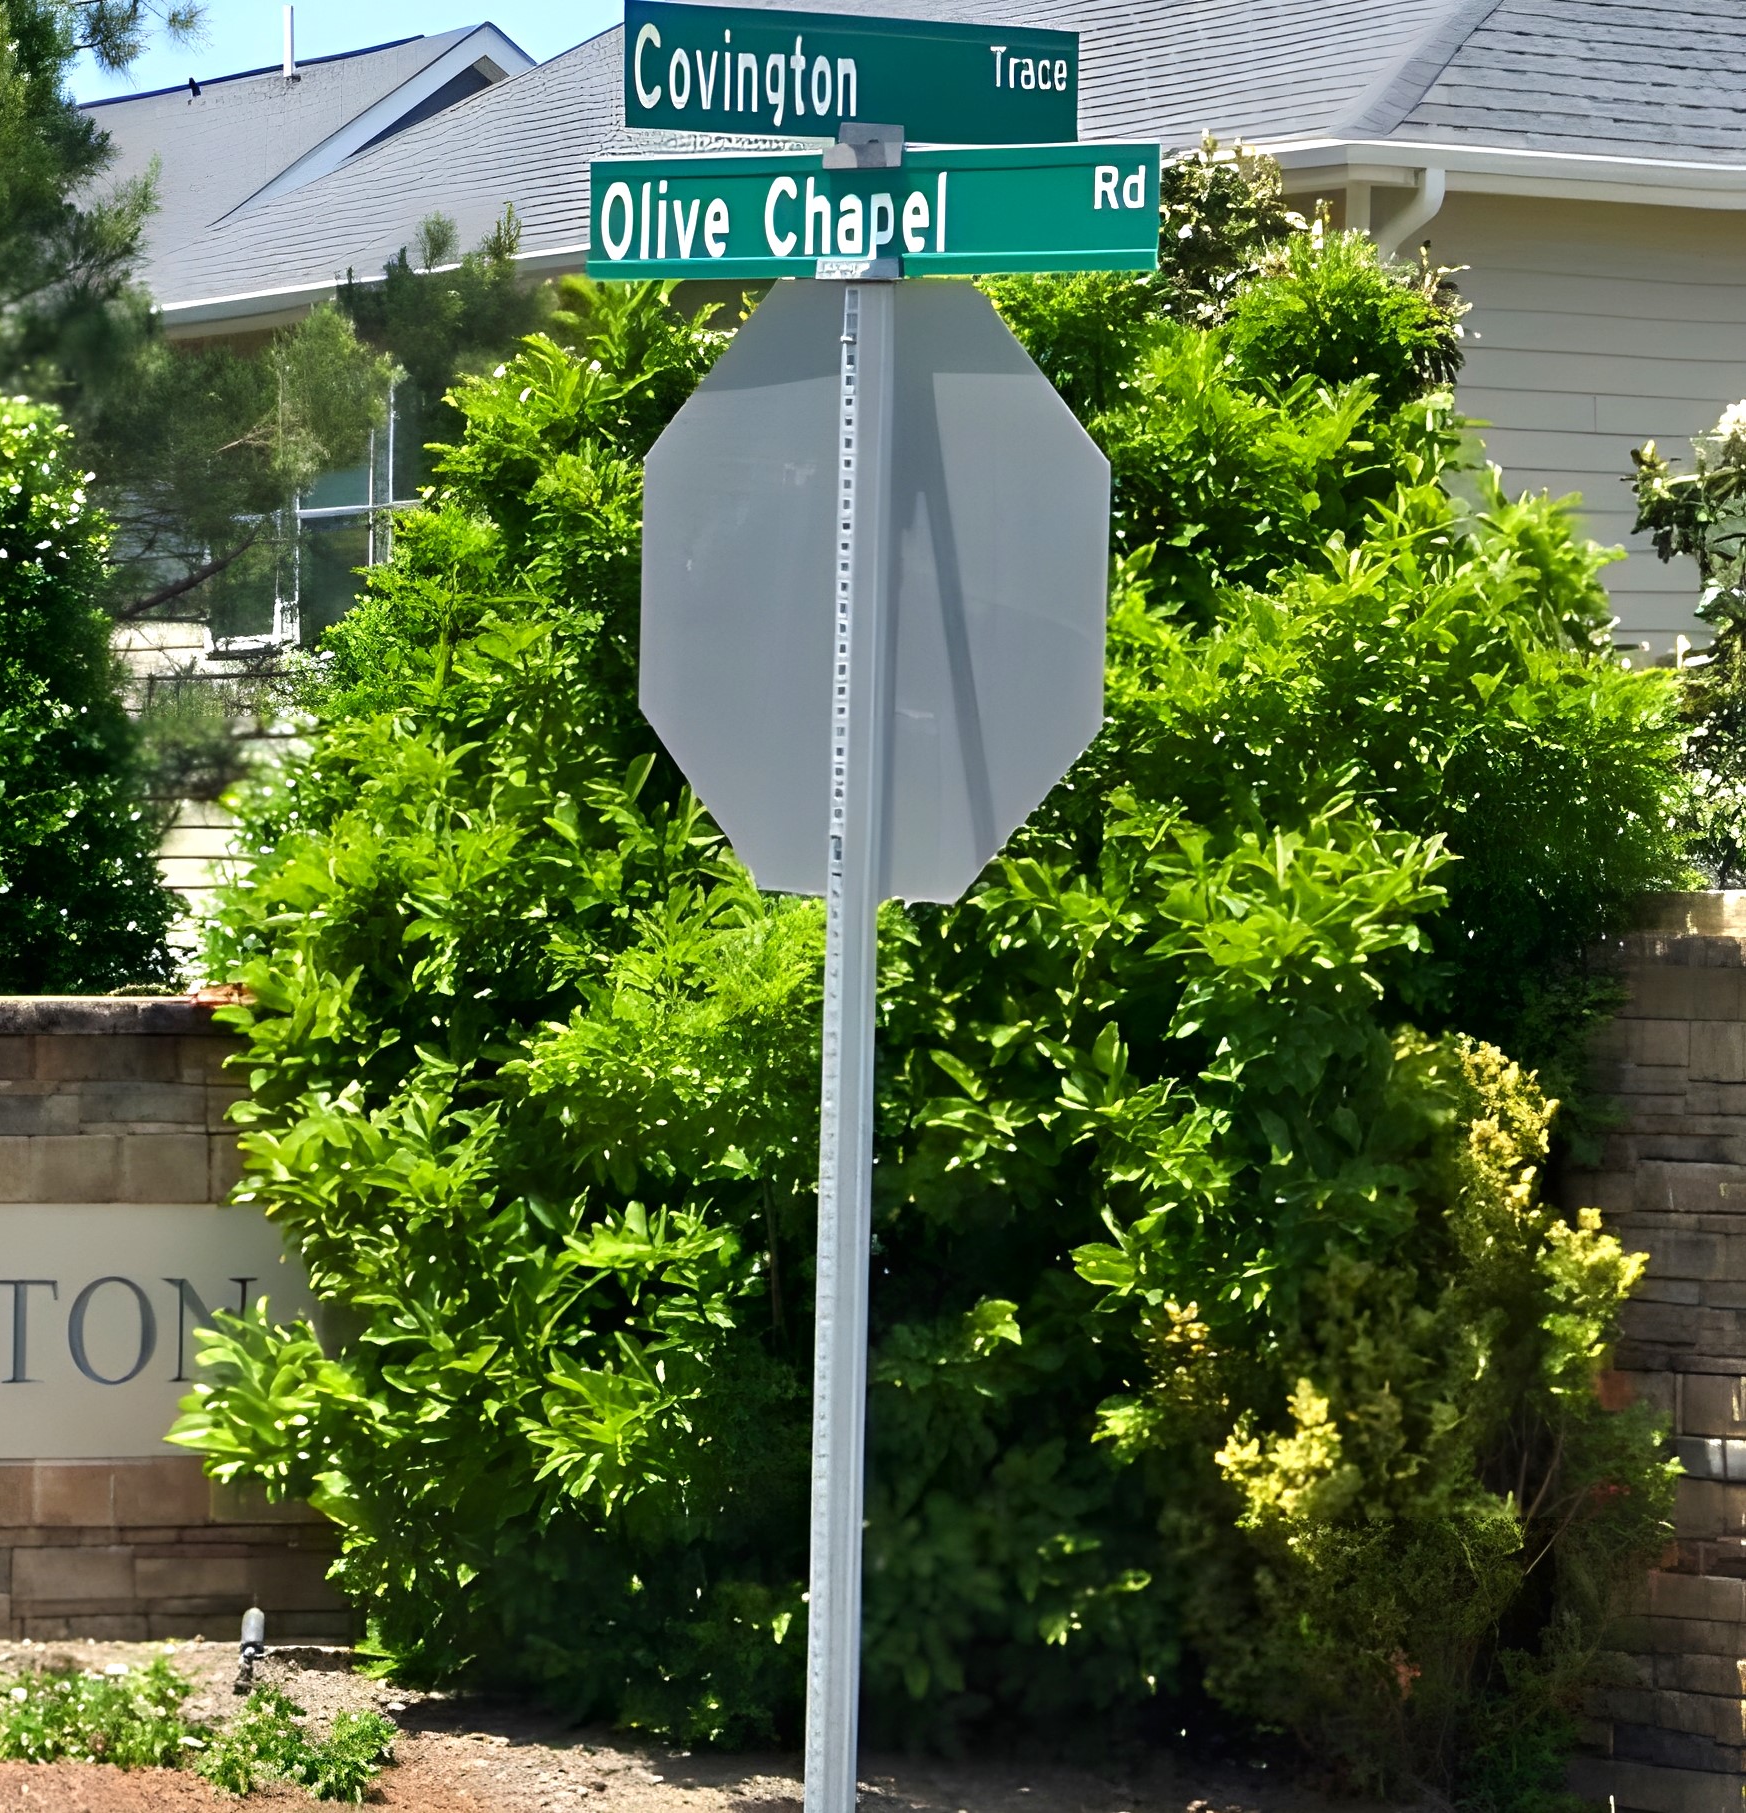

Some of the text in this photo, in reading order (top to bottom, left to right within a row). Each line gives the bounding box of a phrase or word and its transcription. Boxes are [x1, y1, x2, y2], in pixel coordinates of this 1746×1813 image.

[634, 22, 1068, 127] Covington Trace
[600, 165, 1147, 261] Olive Chapel Rd
